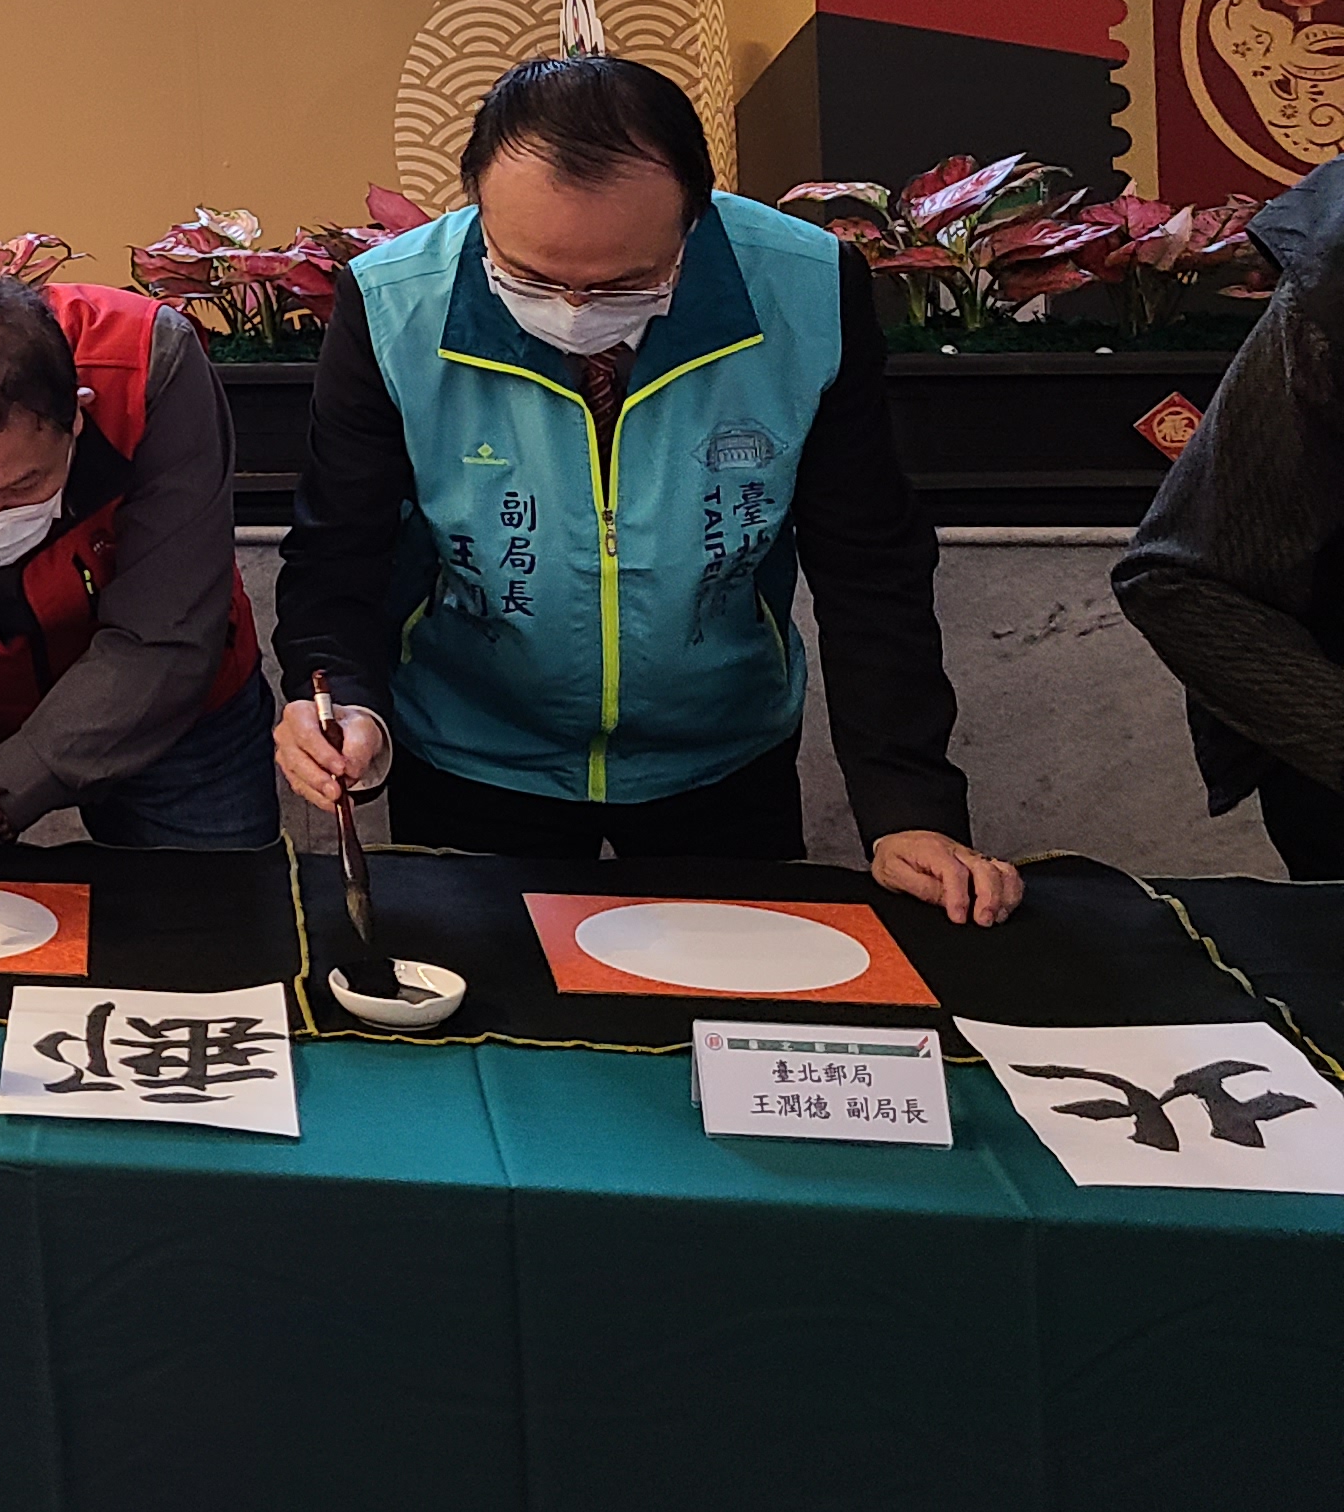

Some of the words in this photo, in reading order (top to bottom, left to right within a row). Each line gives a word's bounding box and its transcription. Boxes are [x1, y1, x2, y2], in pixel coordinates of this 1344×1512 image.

[499, 491, 537, 617] 副局長
[34, 1001, 286, 1104] 郵
[771, 1059, 873, 1087] 臺北郵局
[846, 1096, 928, 1124] 副局長
[1008, 1060, 1317, 1152] 北
